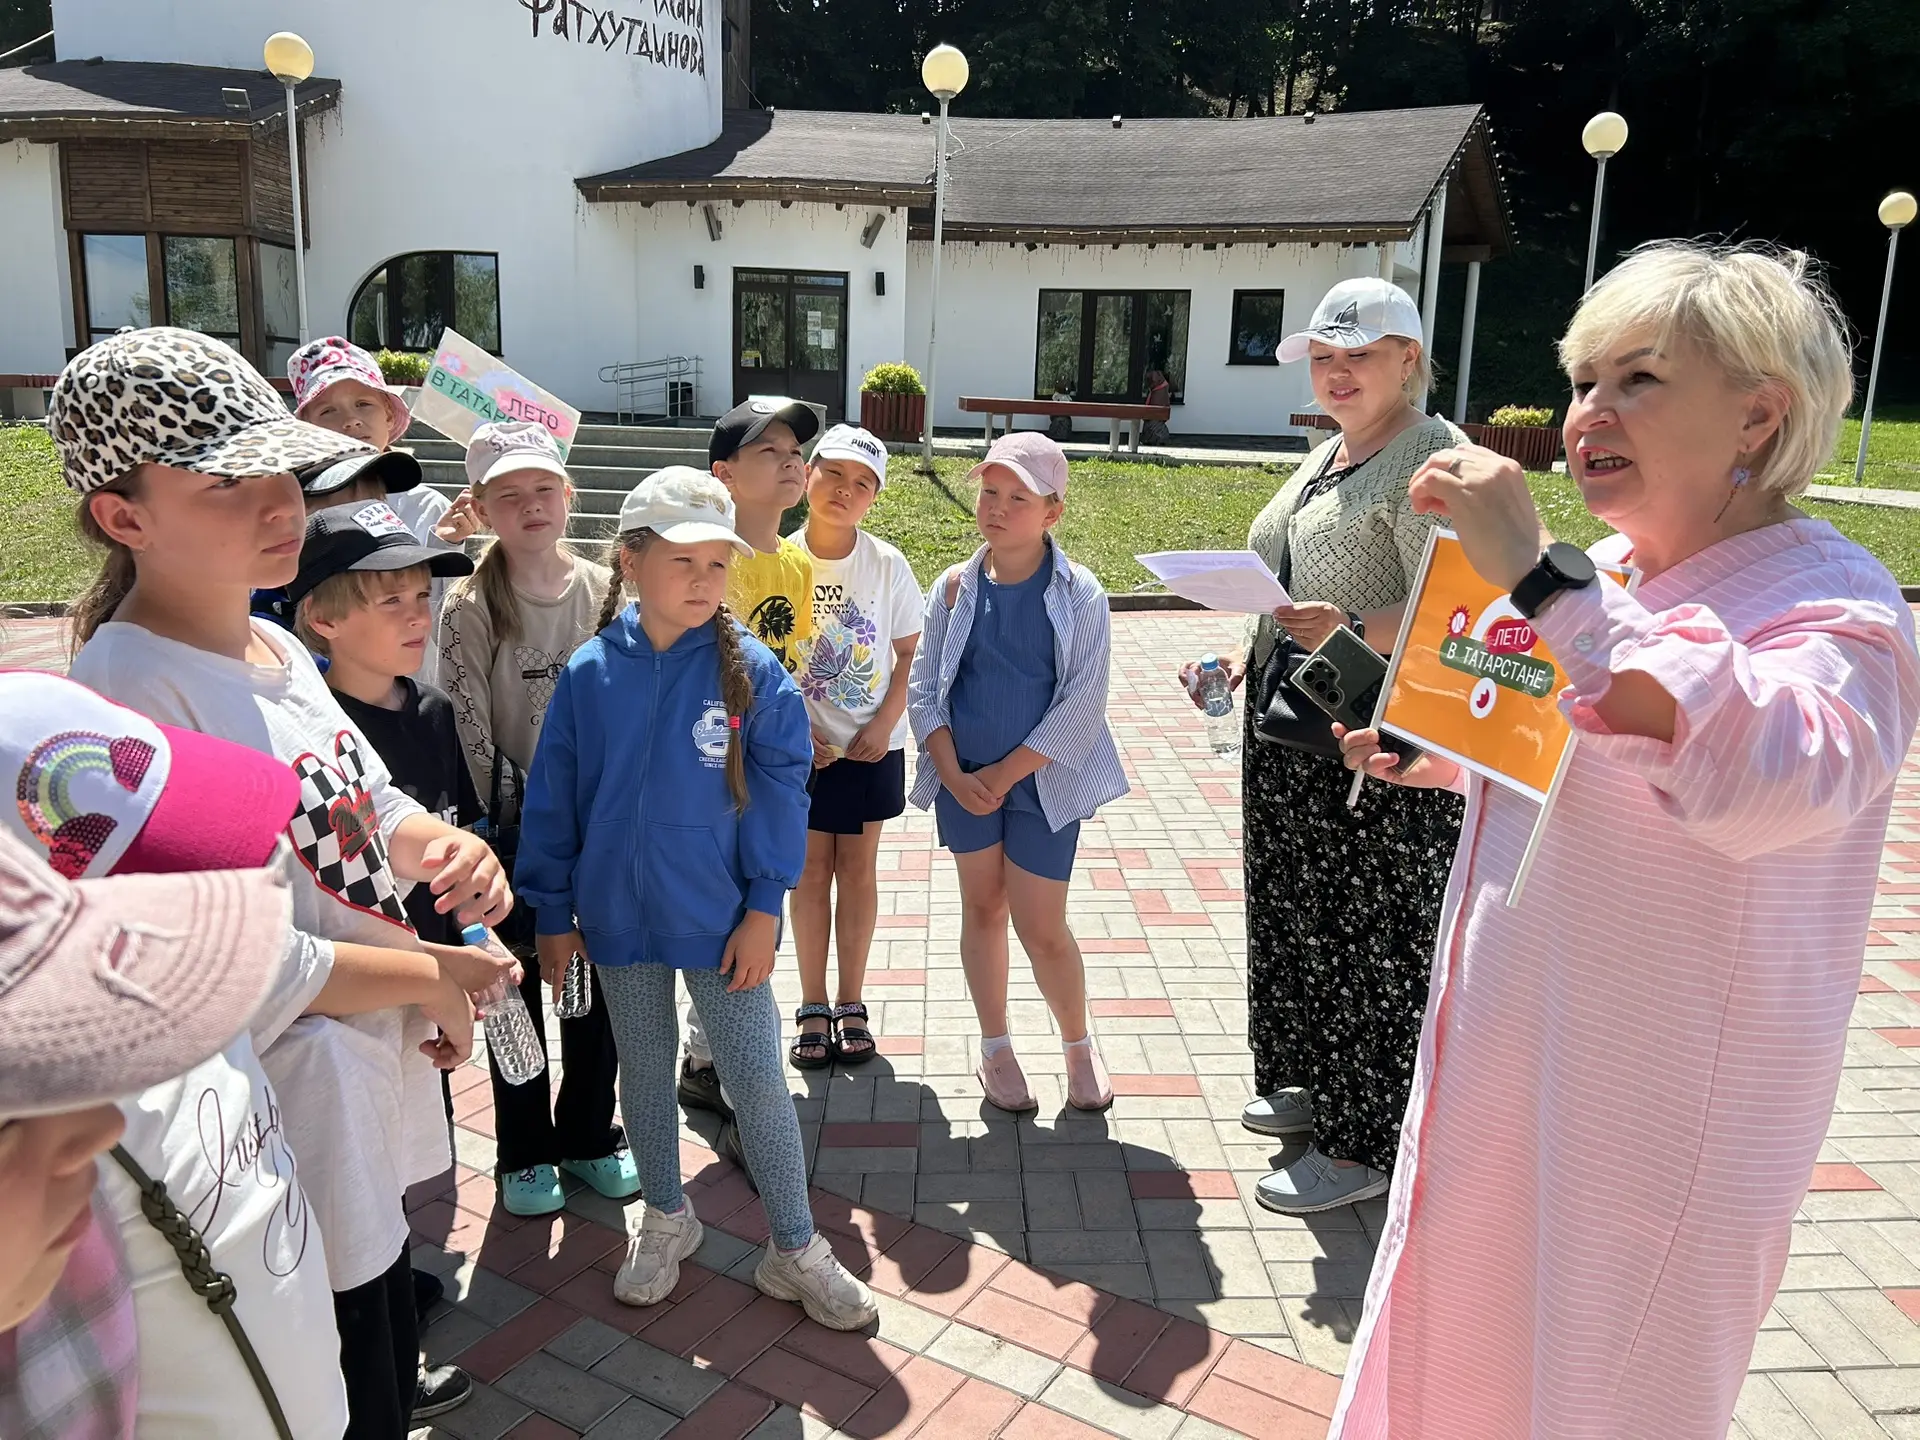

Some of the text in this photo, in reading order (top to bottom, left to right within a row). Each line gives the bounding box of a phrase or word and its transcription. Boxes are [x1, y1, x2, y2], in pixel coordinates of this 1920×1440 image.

[431, 369, 446, 387] В
[508, 397, 559, 430] ЛЕТО
[851, 438, 877, 457] PUMA
[1494, 626, 1531, 646] ЛЕТО
[1447, 642, 1546, 690] В ТАТАРСТАНЕ
